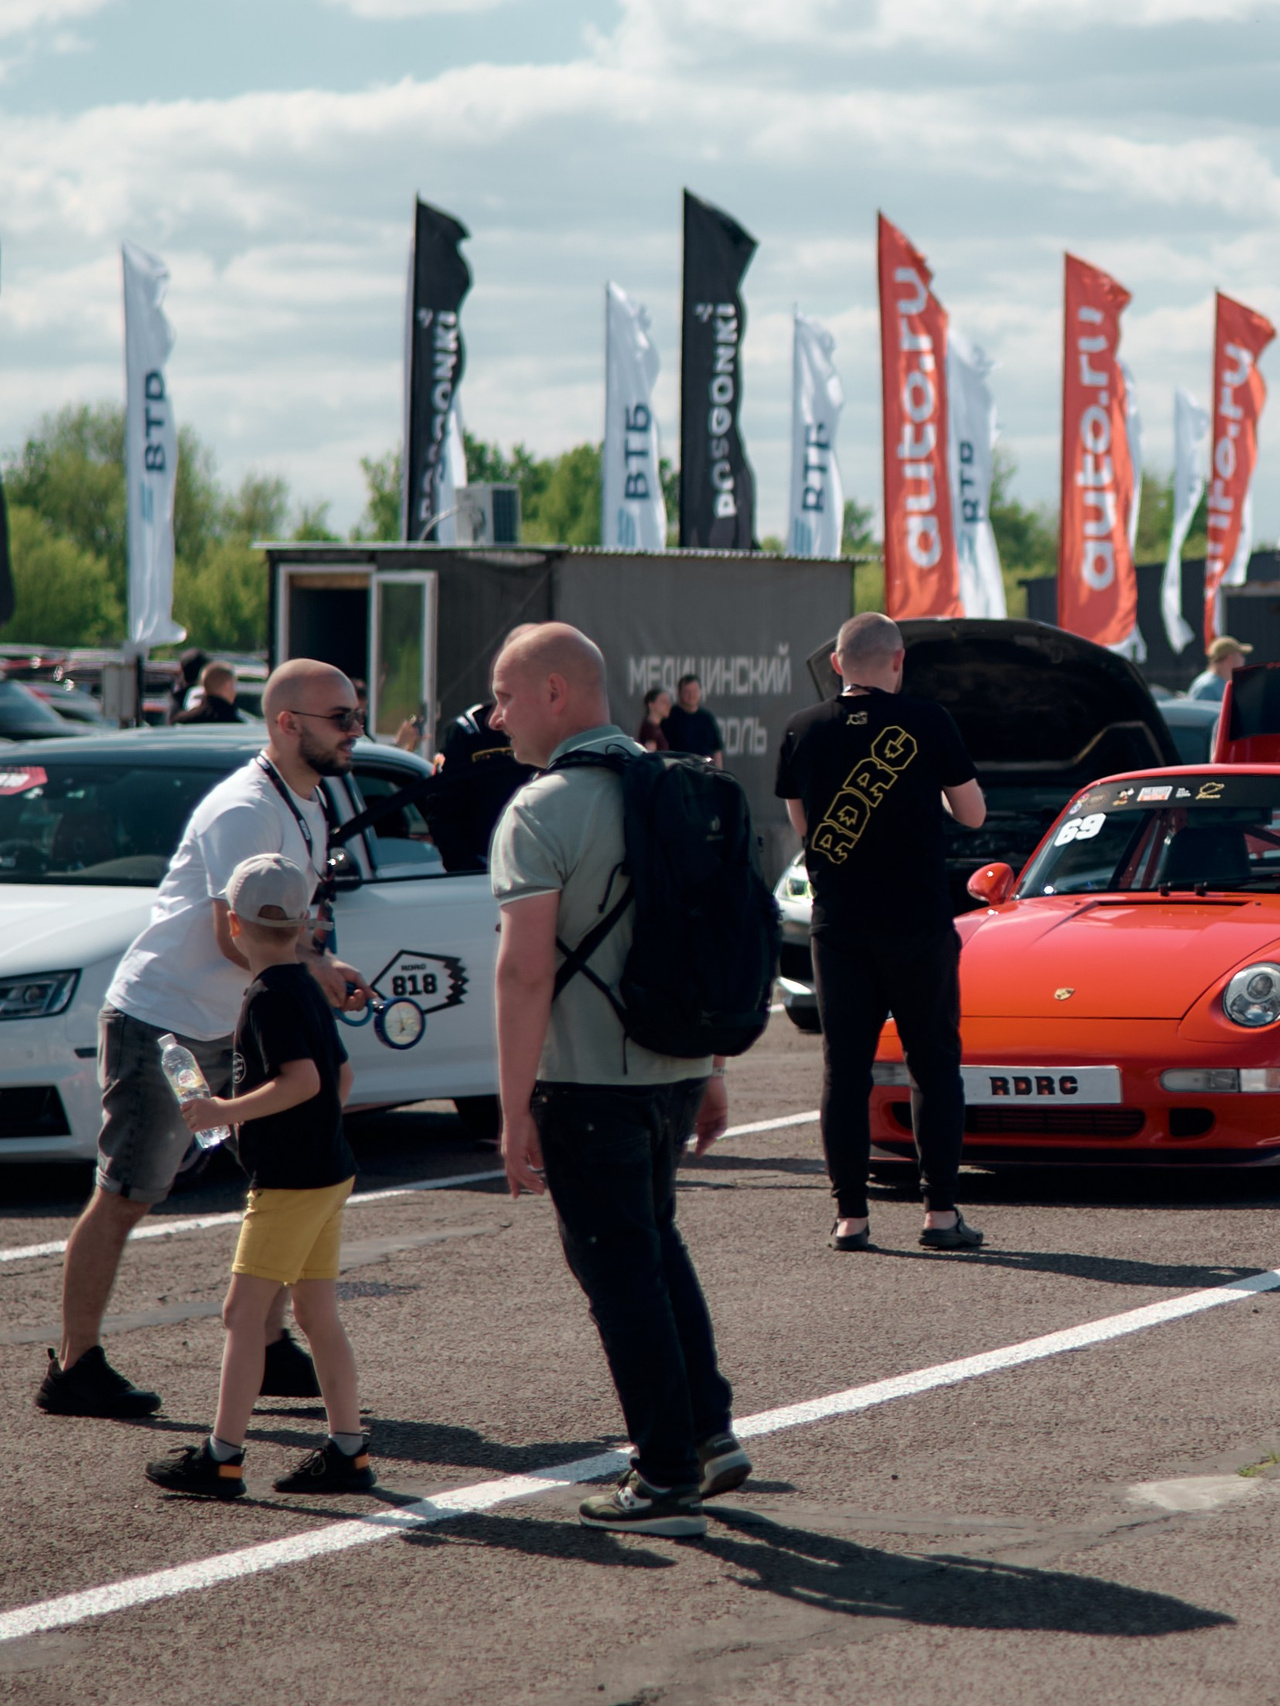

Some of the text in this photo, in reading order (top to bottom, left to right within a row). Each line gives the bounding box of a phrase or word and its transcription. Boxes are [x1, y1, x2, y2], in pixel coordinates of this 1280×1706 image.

[624, 402, 651, 501] ВТБ
[894, 266, 942, 569] auto.ru
[1076, 305, 1117, 591] auto.ru
[811, 725, 918, 864] RDRC
[1054, 813, 1106, 846] 69
[392, 973, 438, 996] 818
[989, 1076, 1078, 1095] RDRC
